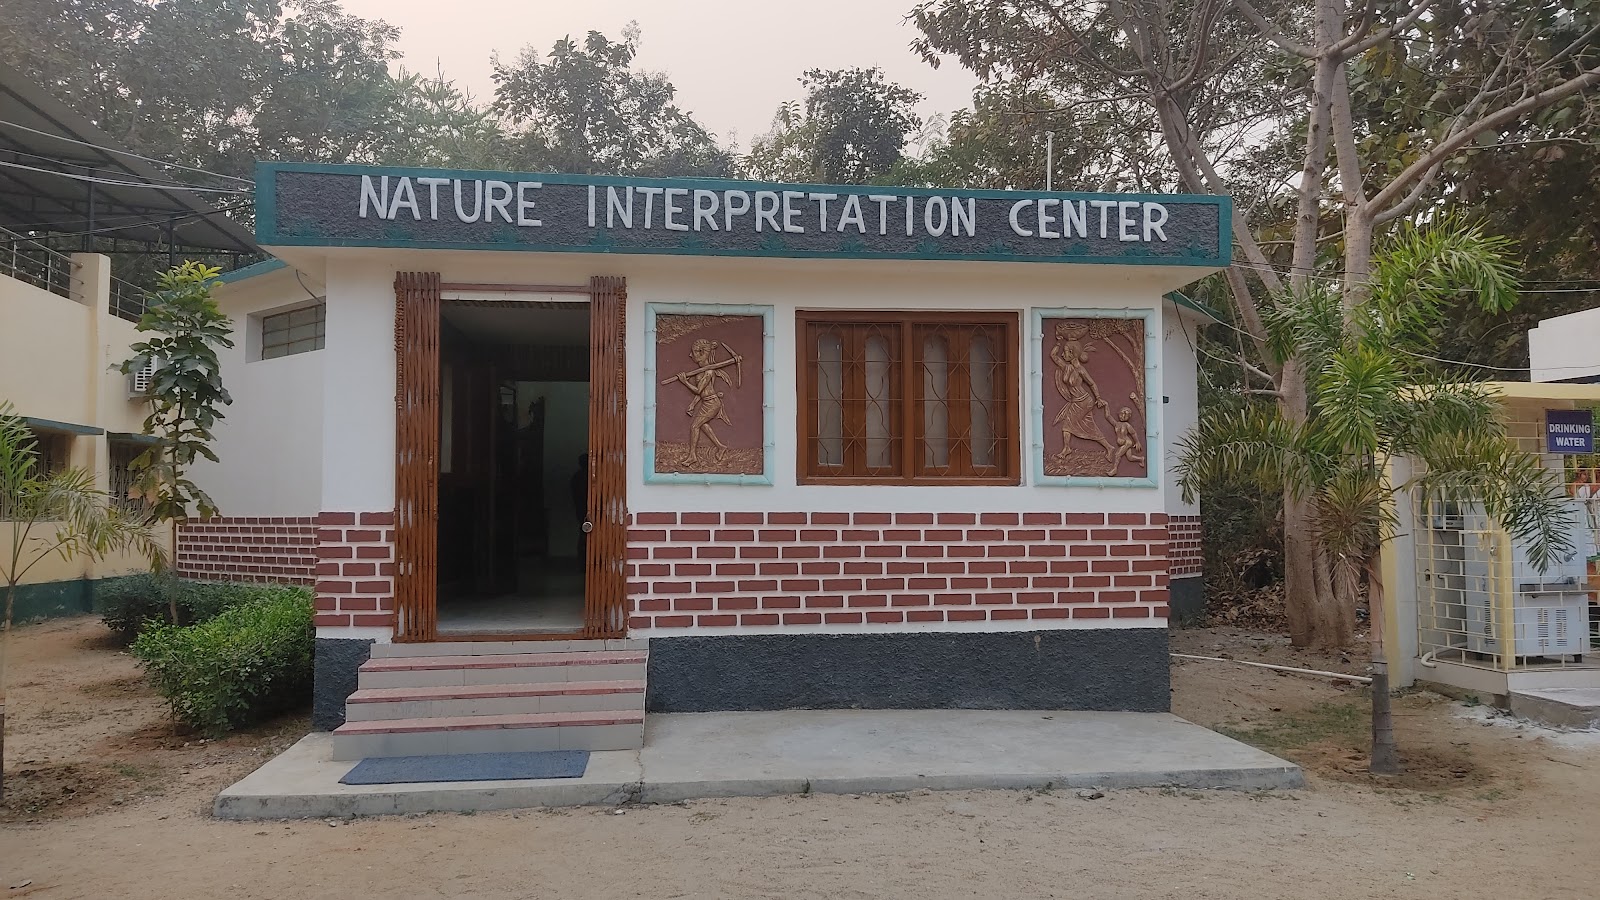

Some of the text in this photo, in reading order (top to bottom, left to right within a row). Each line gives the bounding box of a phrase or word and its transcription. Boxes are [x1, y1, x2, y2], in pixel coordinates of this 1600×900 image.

[359, 174, 1169, 242] NATURE INTERPRETATION CENTER
[1549, 423, 1591, 434] DRINKING
[1555, 436, 1586, 447] WATER
